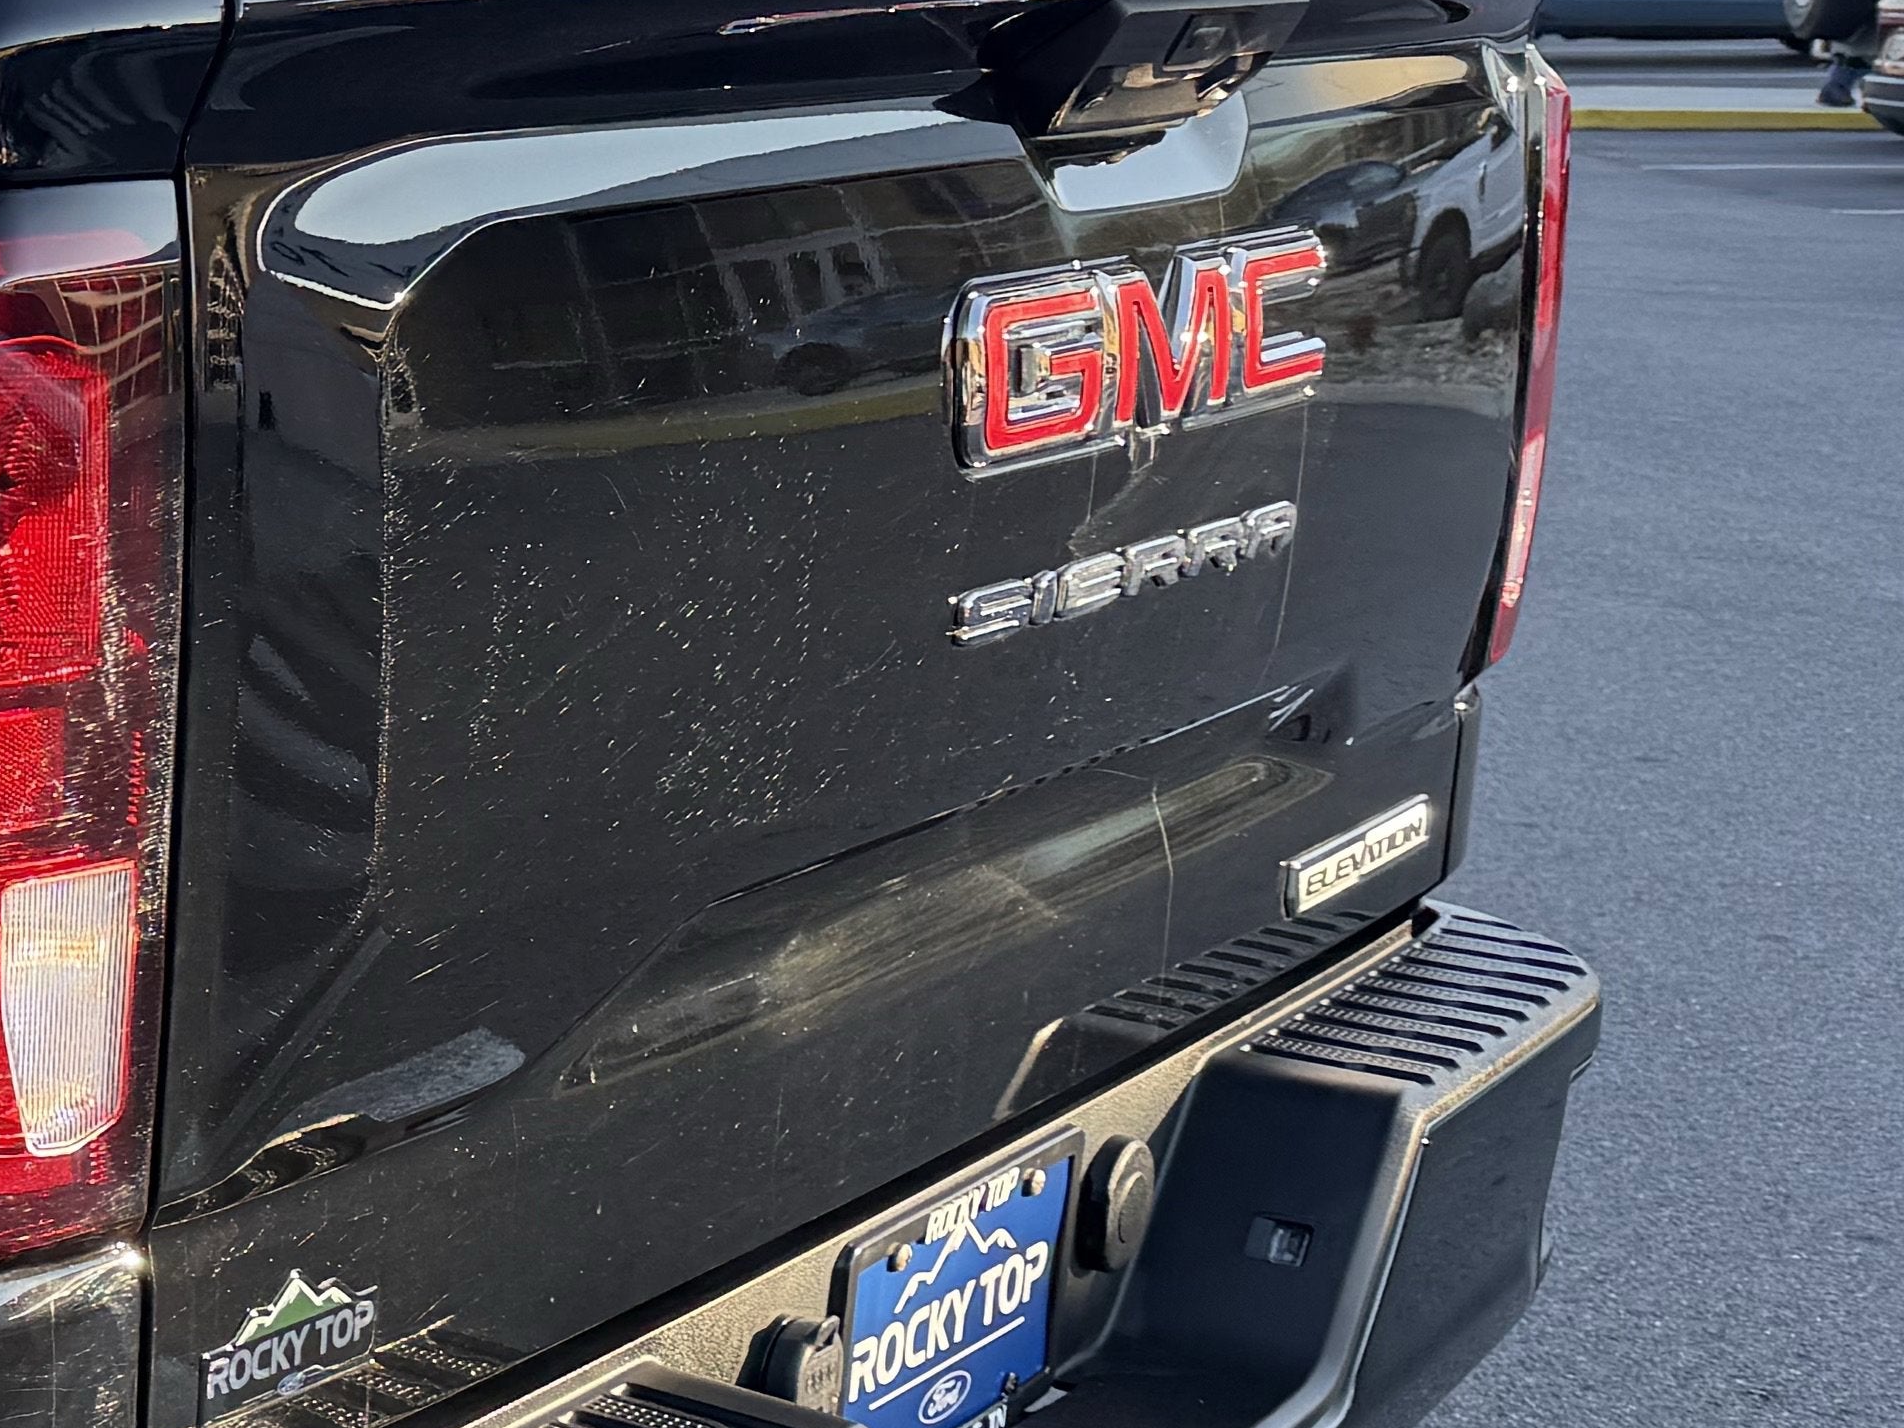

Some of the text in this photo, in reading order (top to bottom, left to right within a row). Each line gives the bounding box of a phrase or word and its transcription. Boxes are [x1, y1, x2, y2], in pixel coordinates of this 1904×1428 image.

[960, 234, 1326, 465] GMC
[947, 500, 1298, 648] SIERRA
[1304, 817, 1429, 897] ELEVATION
[984, 1166, 1021, 1213] TOP
[206, 1323, 311, 1400] ROCKY
[314, 1299, 376, 1356] TOP
[847, 1278, 978, 1403] ROCKY
[980, 1240, 1050, 1326] TOP
